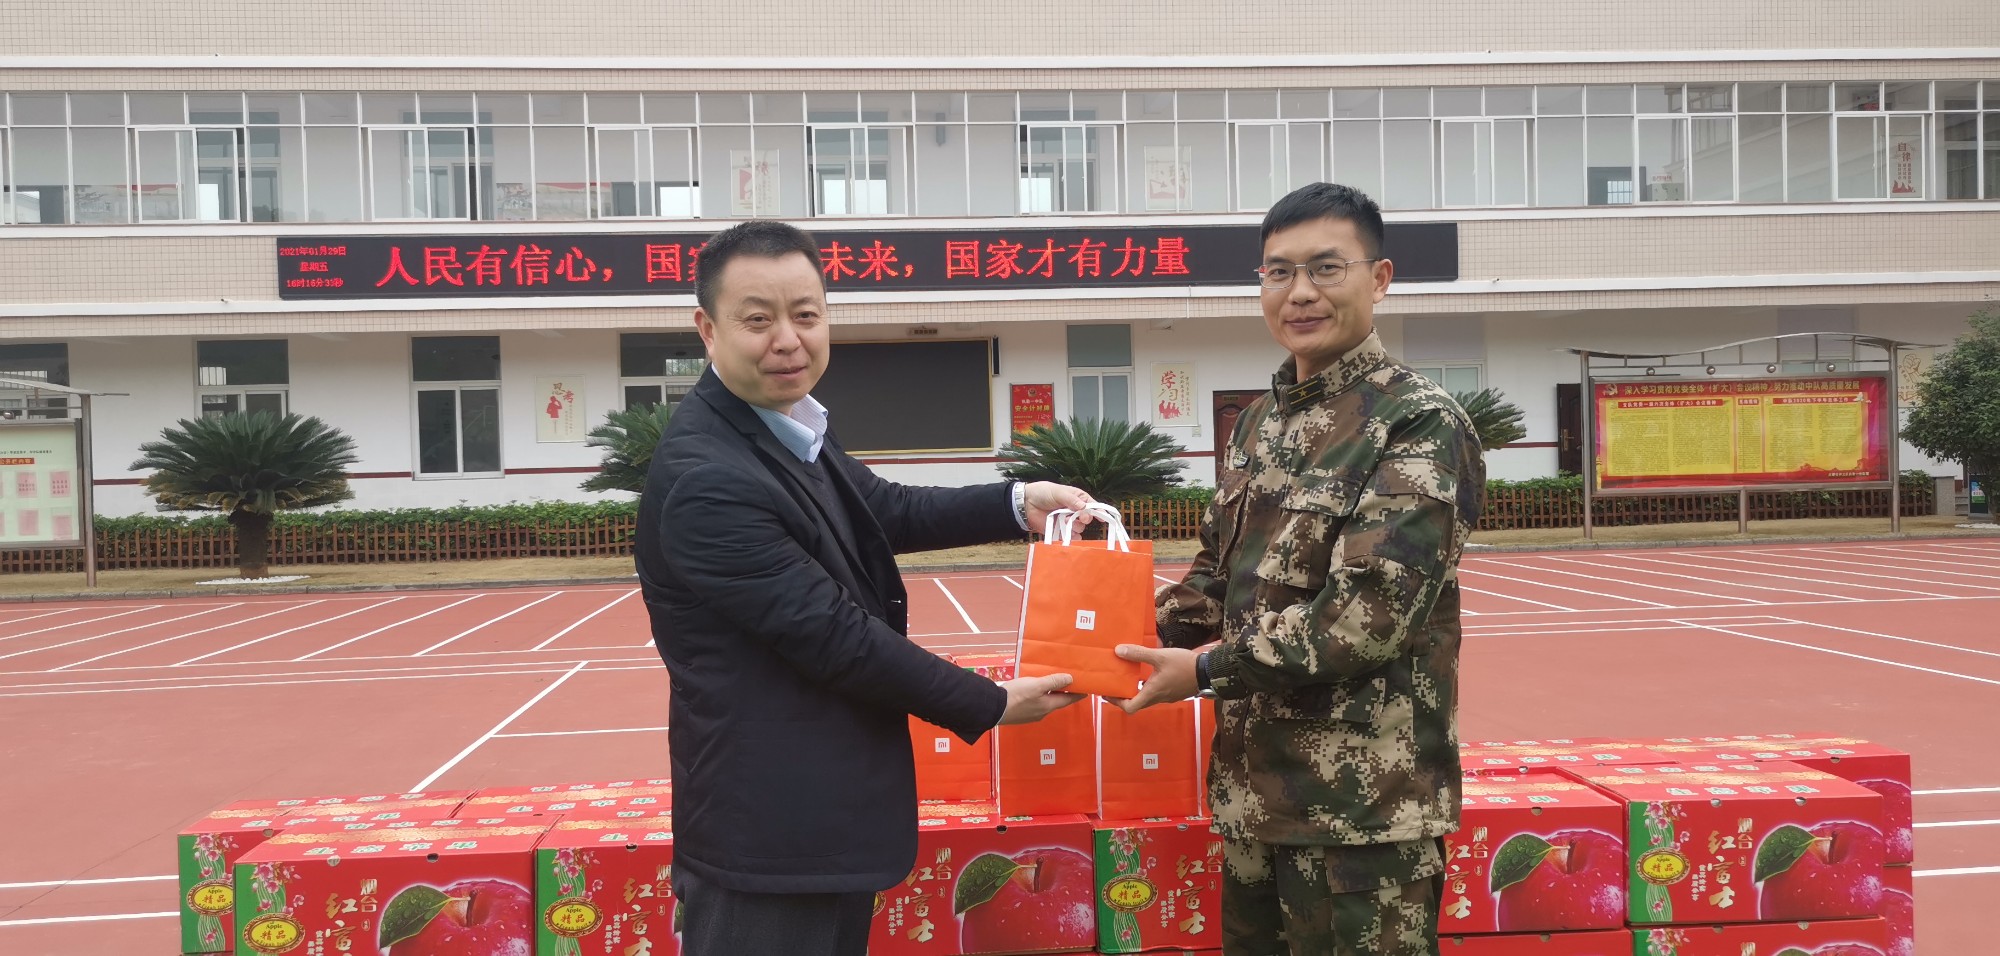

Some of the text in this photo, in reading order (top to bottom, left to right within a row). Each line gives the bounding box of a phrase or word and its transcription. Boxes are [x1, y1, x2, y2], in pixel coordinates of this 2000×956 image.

[279, 245, 347, 256] 2021年01月29日
[299, 261, 329, 272] 星期五
[325, 892, 358, 956] 红富
